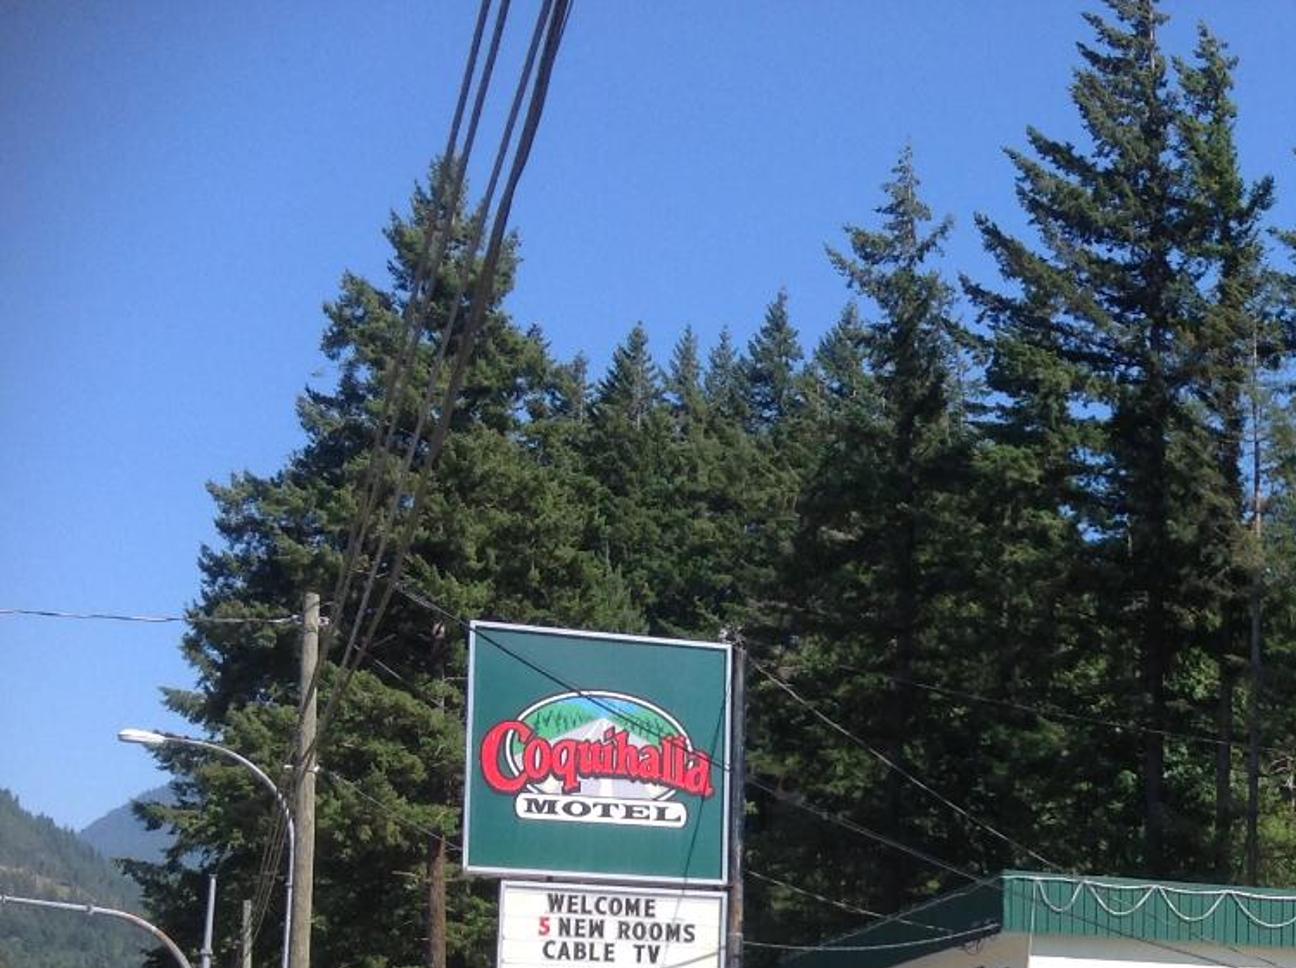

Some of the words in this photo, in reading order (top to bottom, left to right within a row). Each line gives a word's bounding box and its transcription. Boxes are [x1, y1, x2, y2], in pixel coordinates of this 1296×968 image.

[480, 720, 714, 798] Coquihalla
[524, 797, 682, 823] MOTEL
[547, 893, 656, 918] WELCOME
[538, 916, 551, 937] 5
[558, 918, 605, 939] NEW
[618, 920, 696, 943] ROOMS
[542, 940, 616, 962] CABLE
[633, 943, 661, 964] TV
